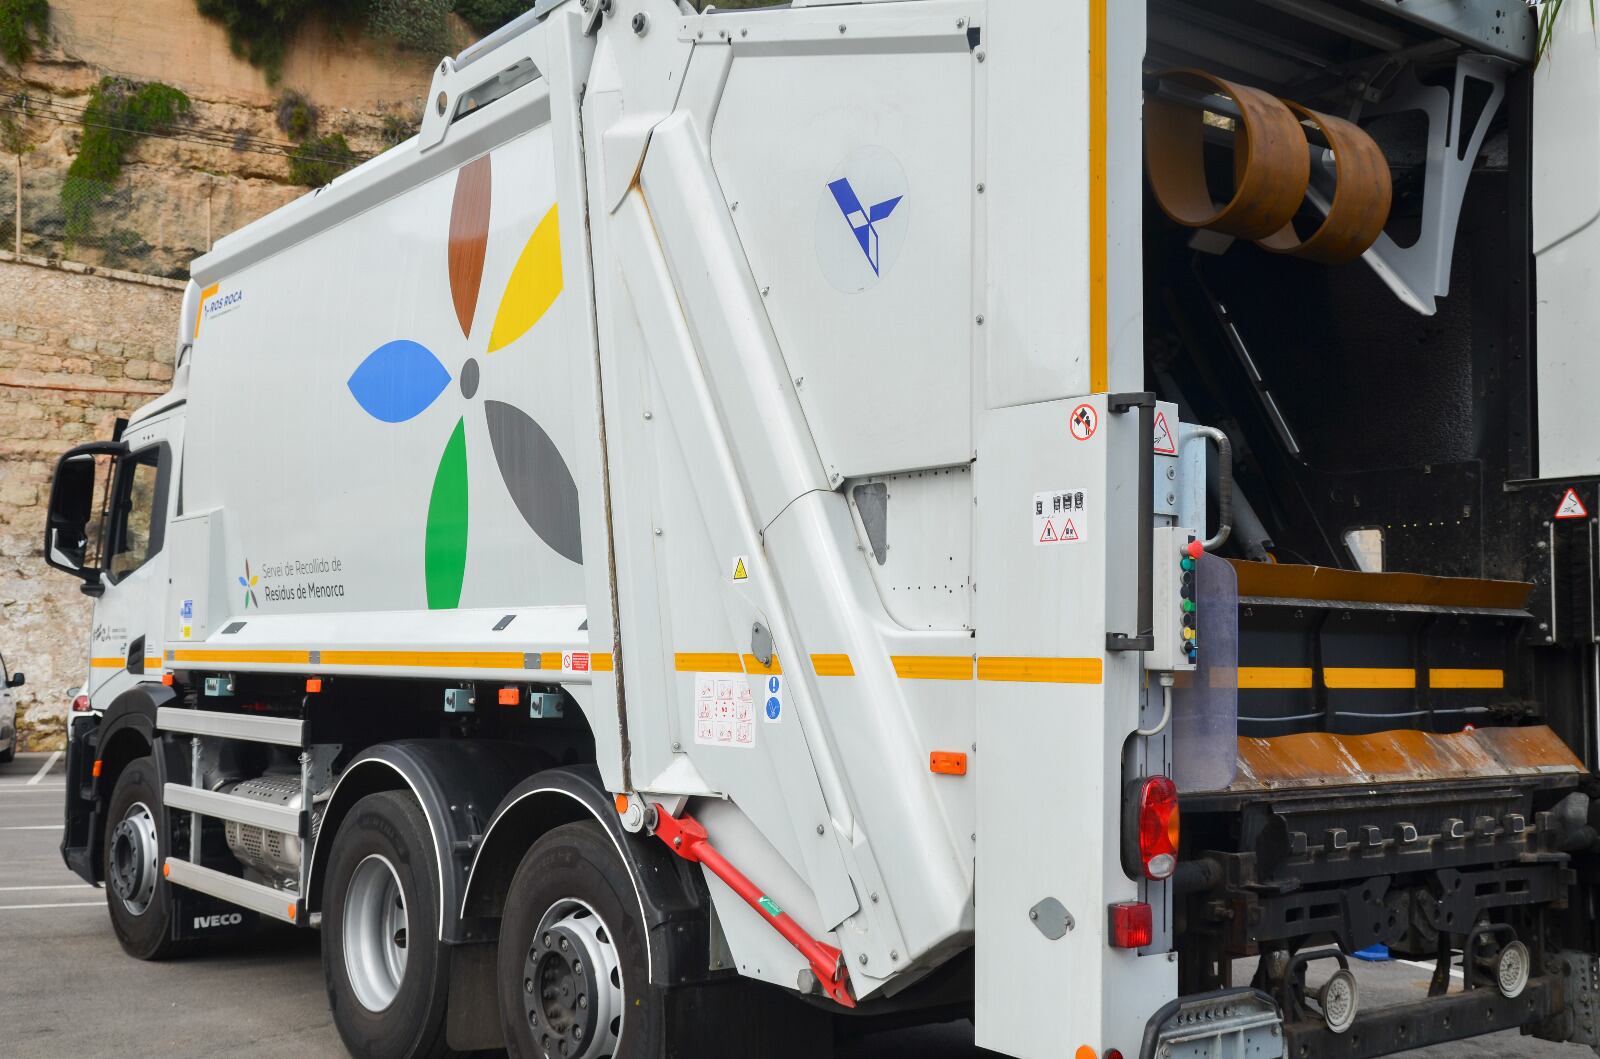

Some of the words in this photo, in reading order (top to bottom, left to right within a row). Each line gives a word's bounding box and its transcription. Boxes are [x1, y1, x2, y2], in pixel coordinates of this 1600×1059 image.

[210, 297, 224, 312] ROS
[224, 289, 243, 305] ROCA
[262, 563, 283, 579] Servei
[284, 561, 294, 577] de
[331, 556, 342, 573] de
[265, 585, 295, 602] Residus
[296, 583, 307, 600] de
[307, 581, 345, 600] Menorca
[193, 912, 243, 930] IVECO
